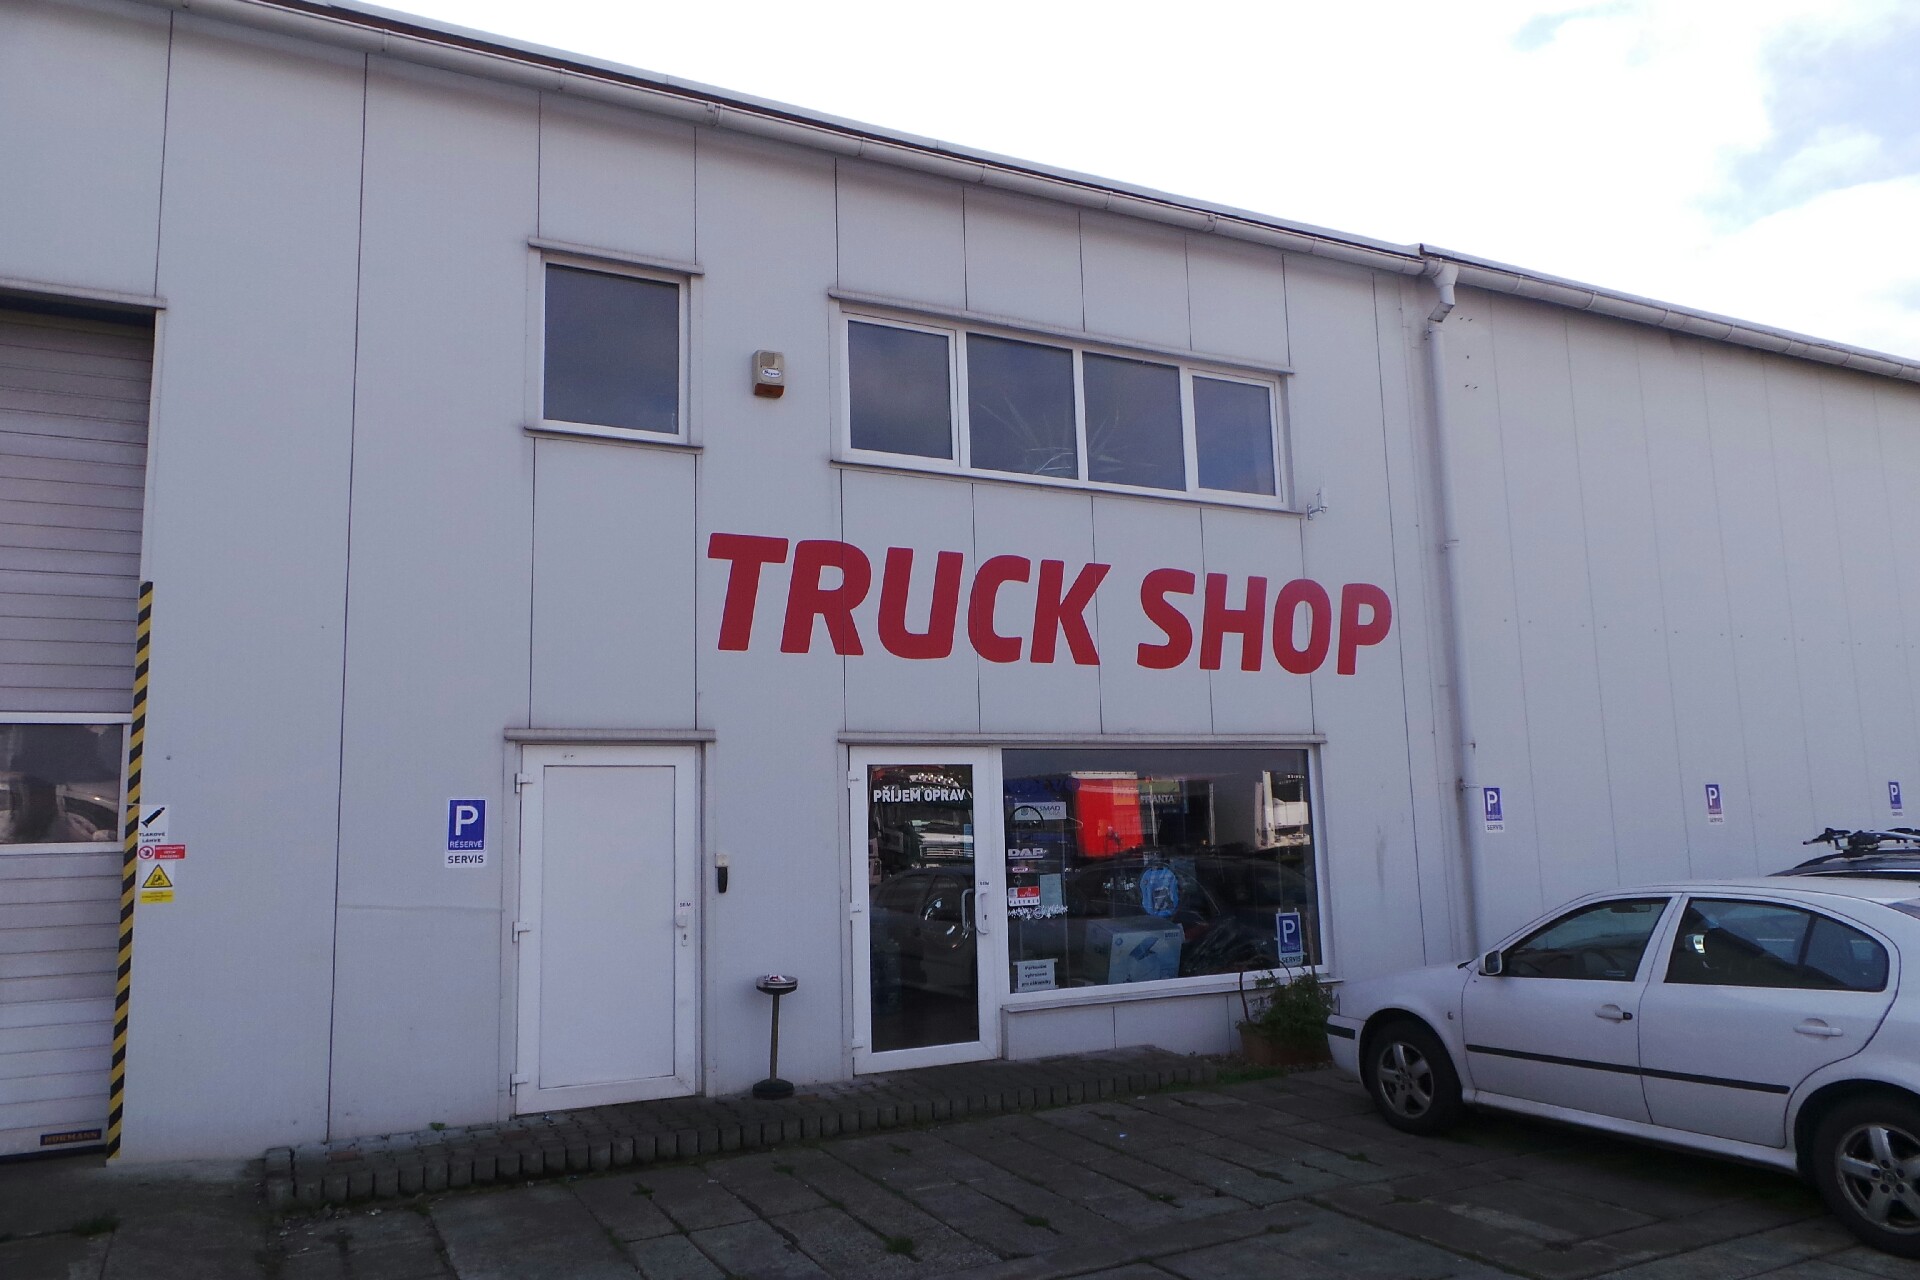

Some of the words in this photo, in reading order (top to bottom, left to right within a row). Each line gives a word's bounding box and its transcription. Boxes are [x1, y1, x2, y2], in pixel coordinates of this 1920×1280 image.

[708, 533, 1111, 665] TRUCK
[1137, 568, 1393, 675] SHOP
[873, 785, 920, 803] PŘÍJEM
[924, 787, 965, 802] OPRAV
[1486, 790, 1498, 812] P
[1708, 787, 1718, 806] P
[1890, 784, 1898, 802] P
[455, 805, 479, 836] P
[447, 855, 484, 864] SERVIS
[1282, 919, 1296, 944] P
[1281, 955, 1301, 964] SERVIS
